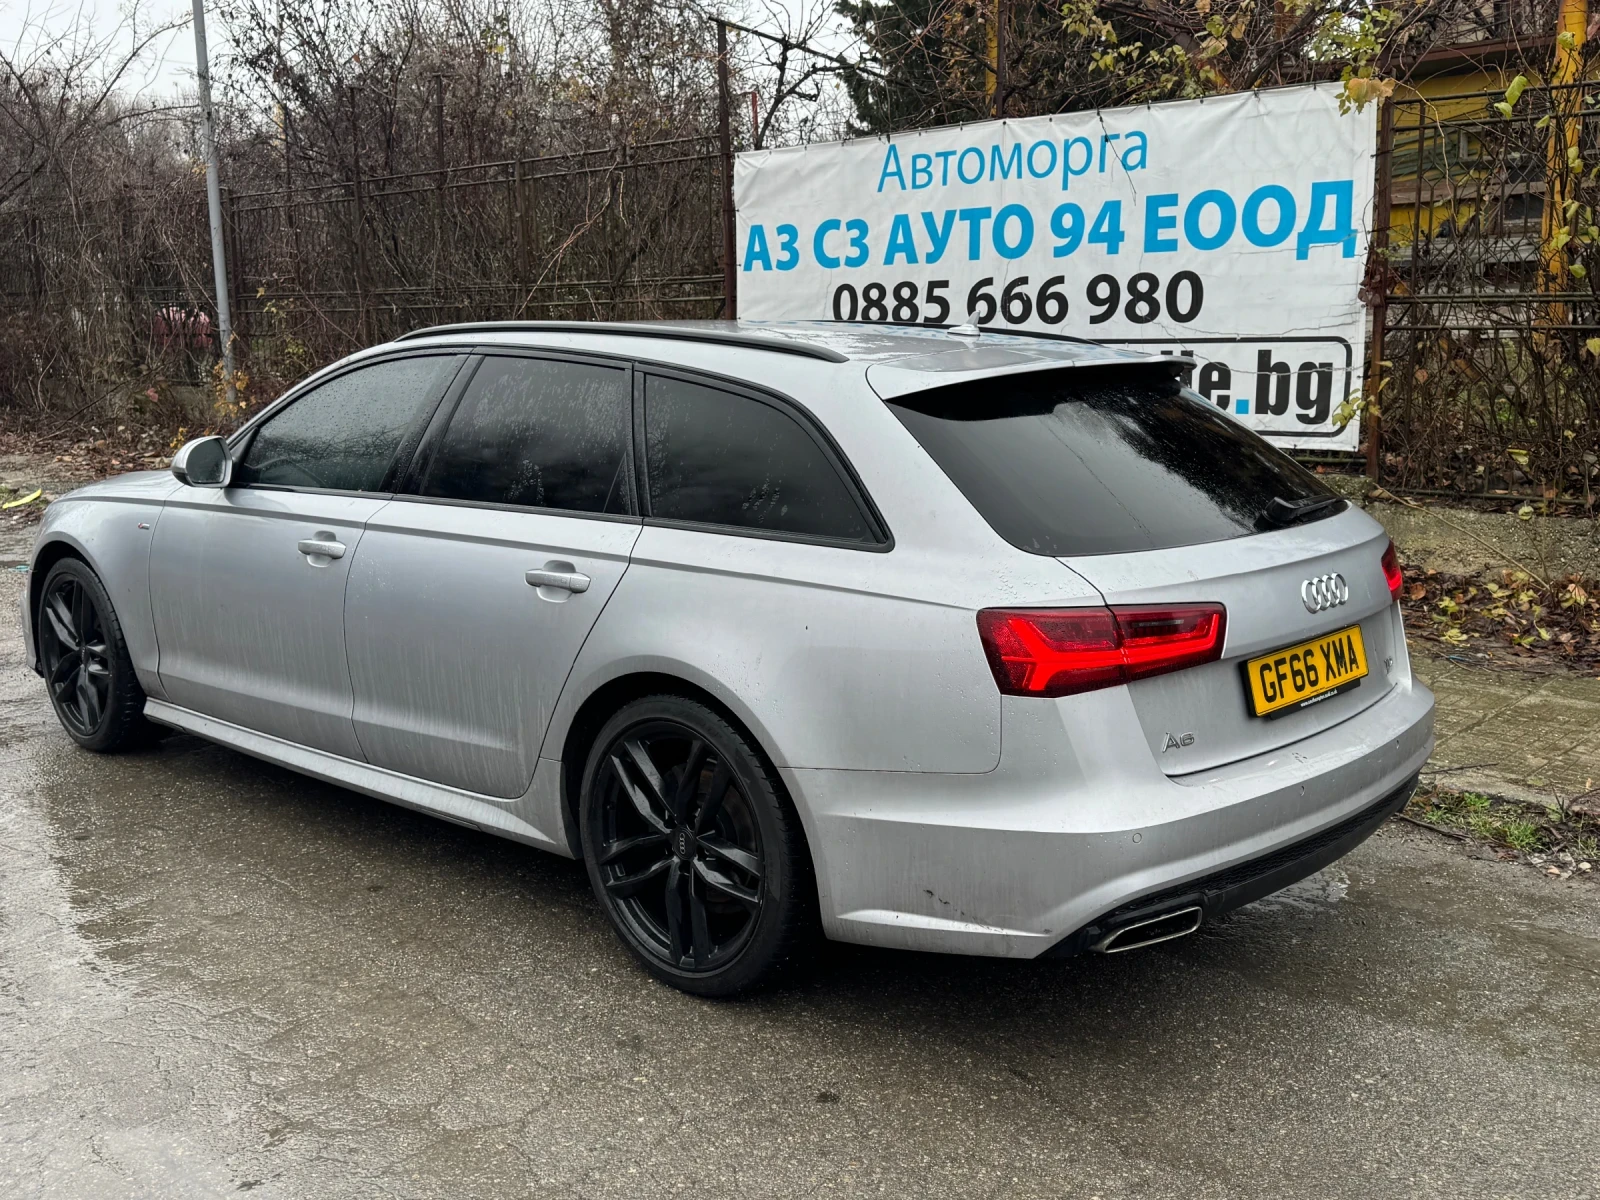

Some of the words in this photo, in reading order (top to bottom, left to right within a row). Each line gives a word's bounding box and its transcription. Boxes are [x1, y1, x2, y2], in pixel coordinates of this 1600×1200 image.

[877, 130, 1148, 193] Автоморга
[883, 203, 1035, 266] АУТО
[1049, 200, 1126, 259] 94
[1143, 179, 1358, 261] ЕООД
[832, 279, 950, 324] 0885
[966, 275, 1069, 325] 666
[1086, 270, 1204, 325] 980
[1259, 648, 1319, 704] GF66
[1319, 634, 1360, 682] XMA
[1162, 731, 1195, 753] A6
